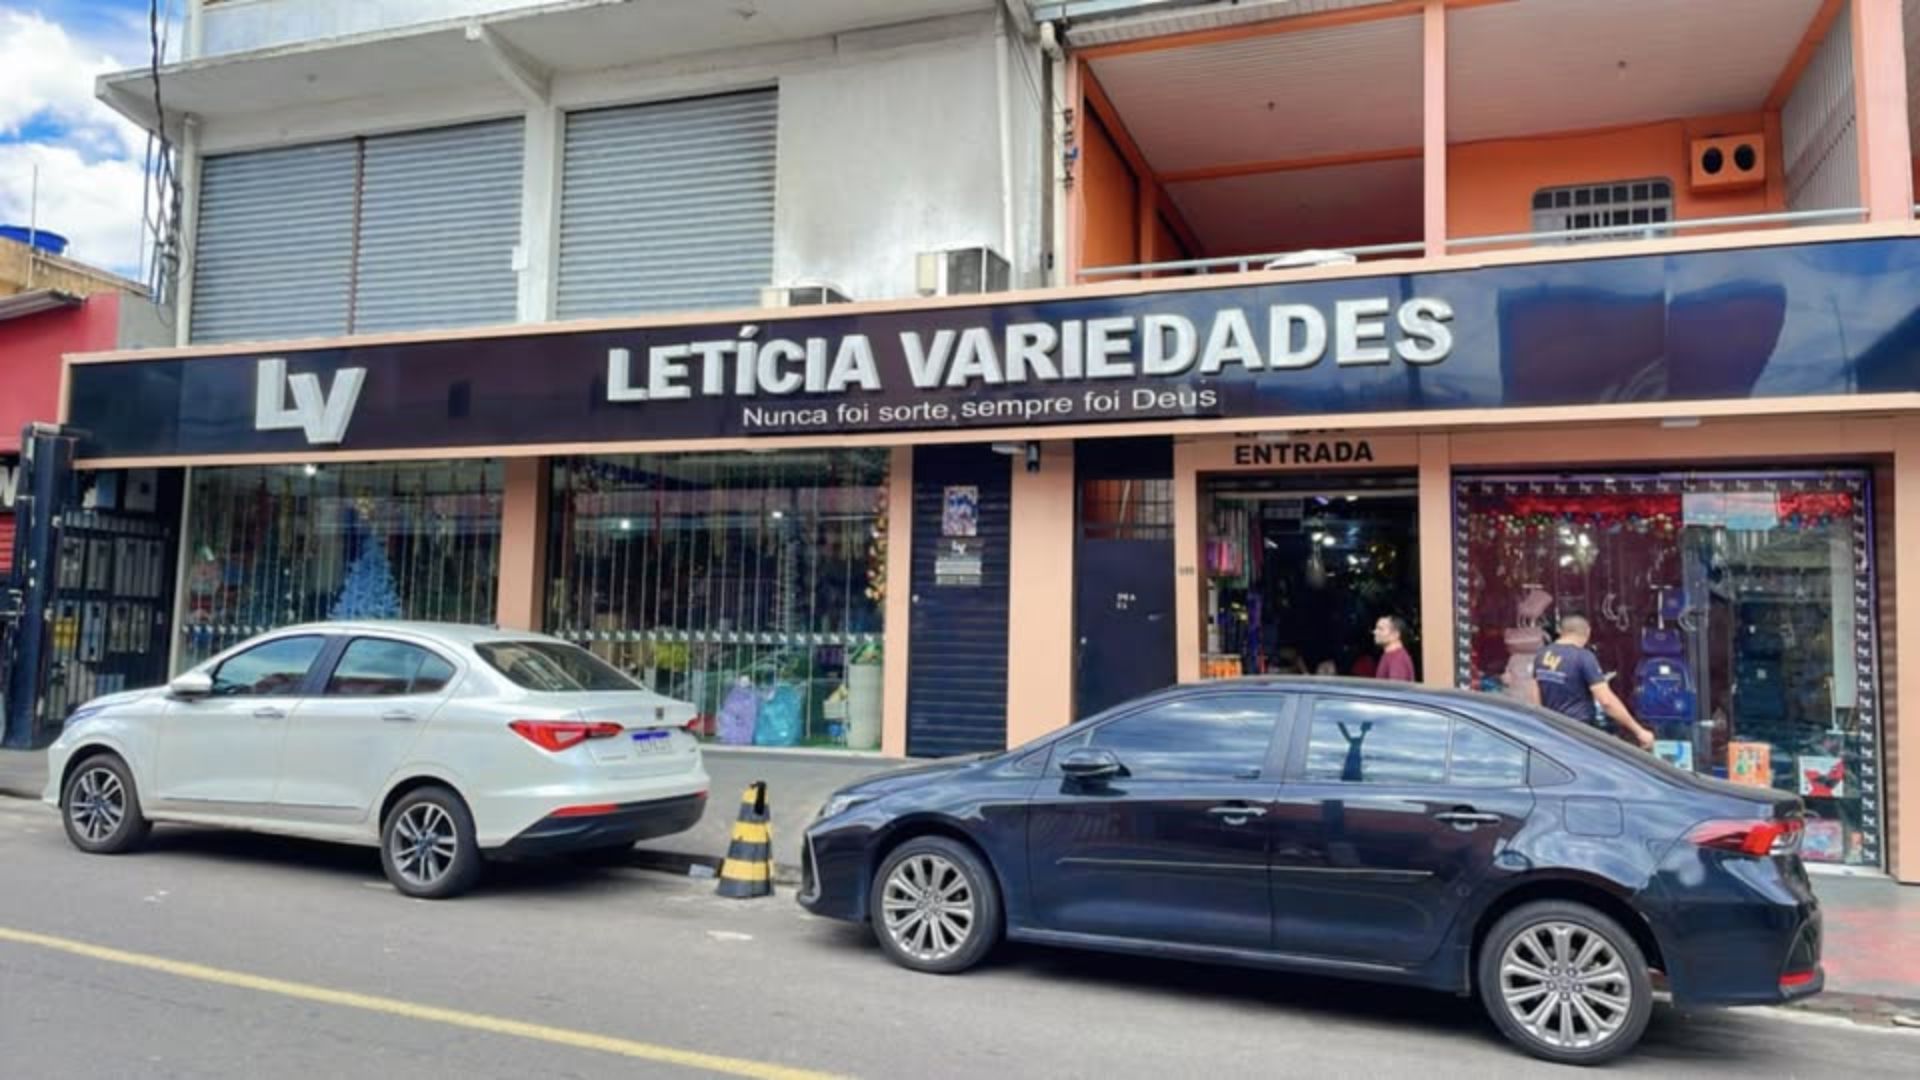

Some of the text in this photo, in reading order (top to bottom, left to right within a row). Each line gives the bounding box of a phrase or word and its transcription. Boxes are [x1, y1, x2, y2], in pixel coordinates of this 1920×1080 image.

[608, 297, 1455, 401] LETÍCIA VARIEDADES
[256, 358, 367, 444] LV
[743, 407, 827, 427] Nunca
[836, 403, 870, 424] foi
[961, 396, 1072, 419] sempre
[1083, 391, 1121, 412] foi
[1131, 388, 1217, 409] Deus
[1234, 441, 1374, 465] ENTRADA
